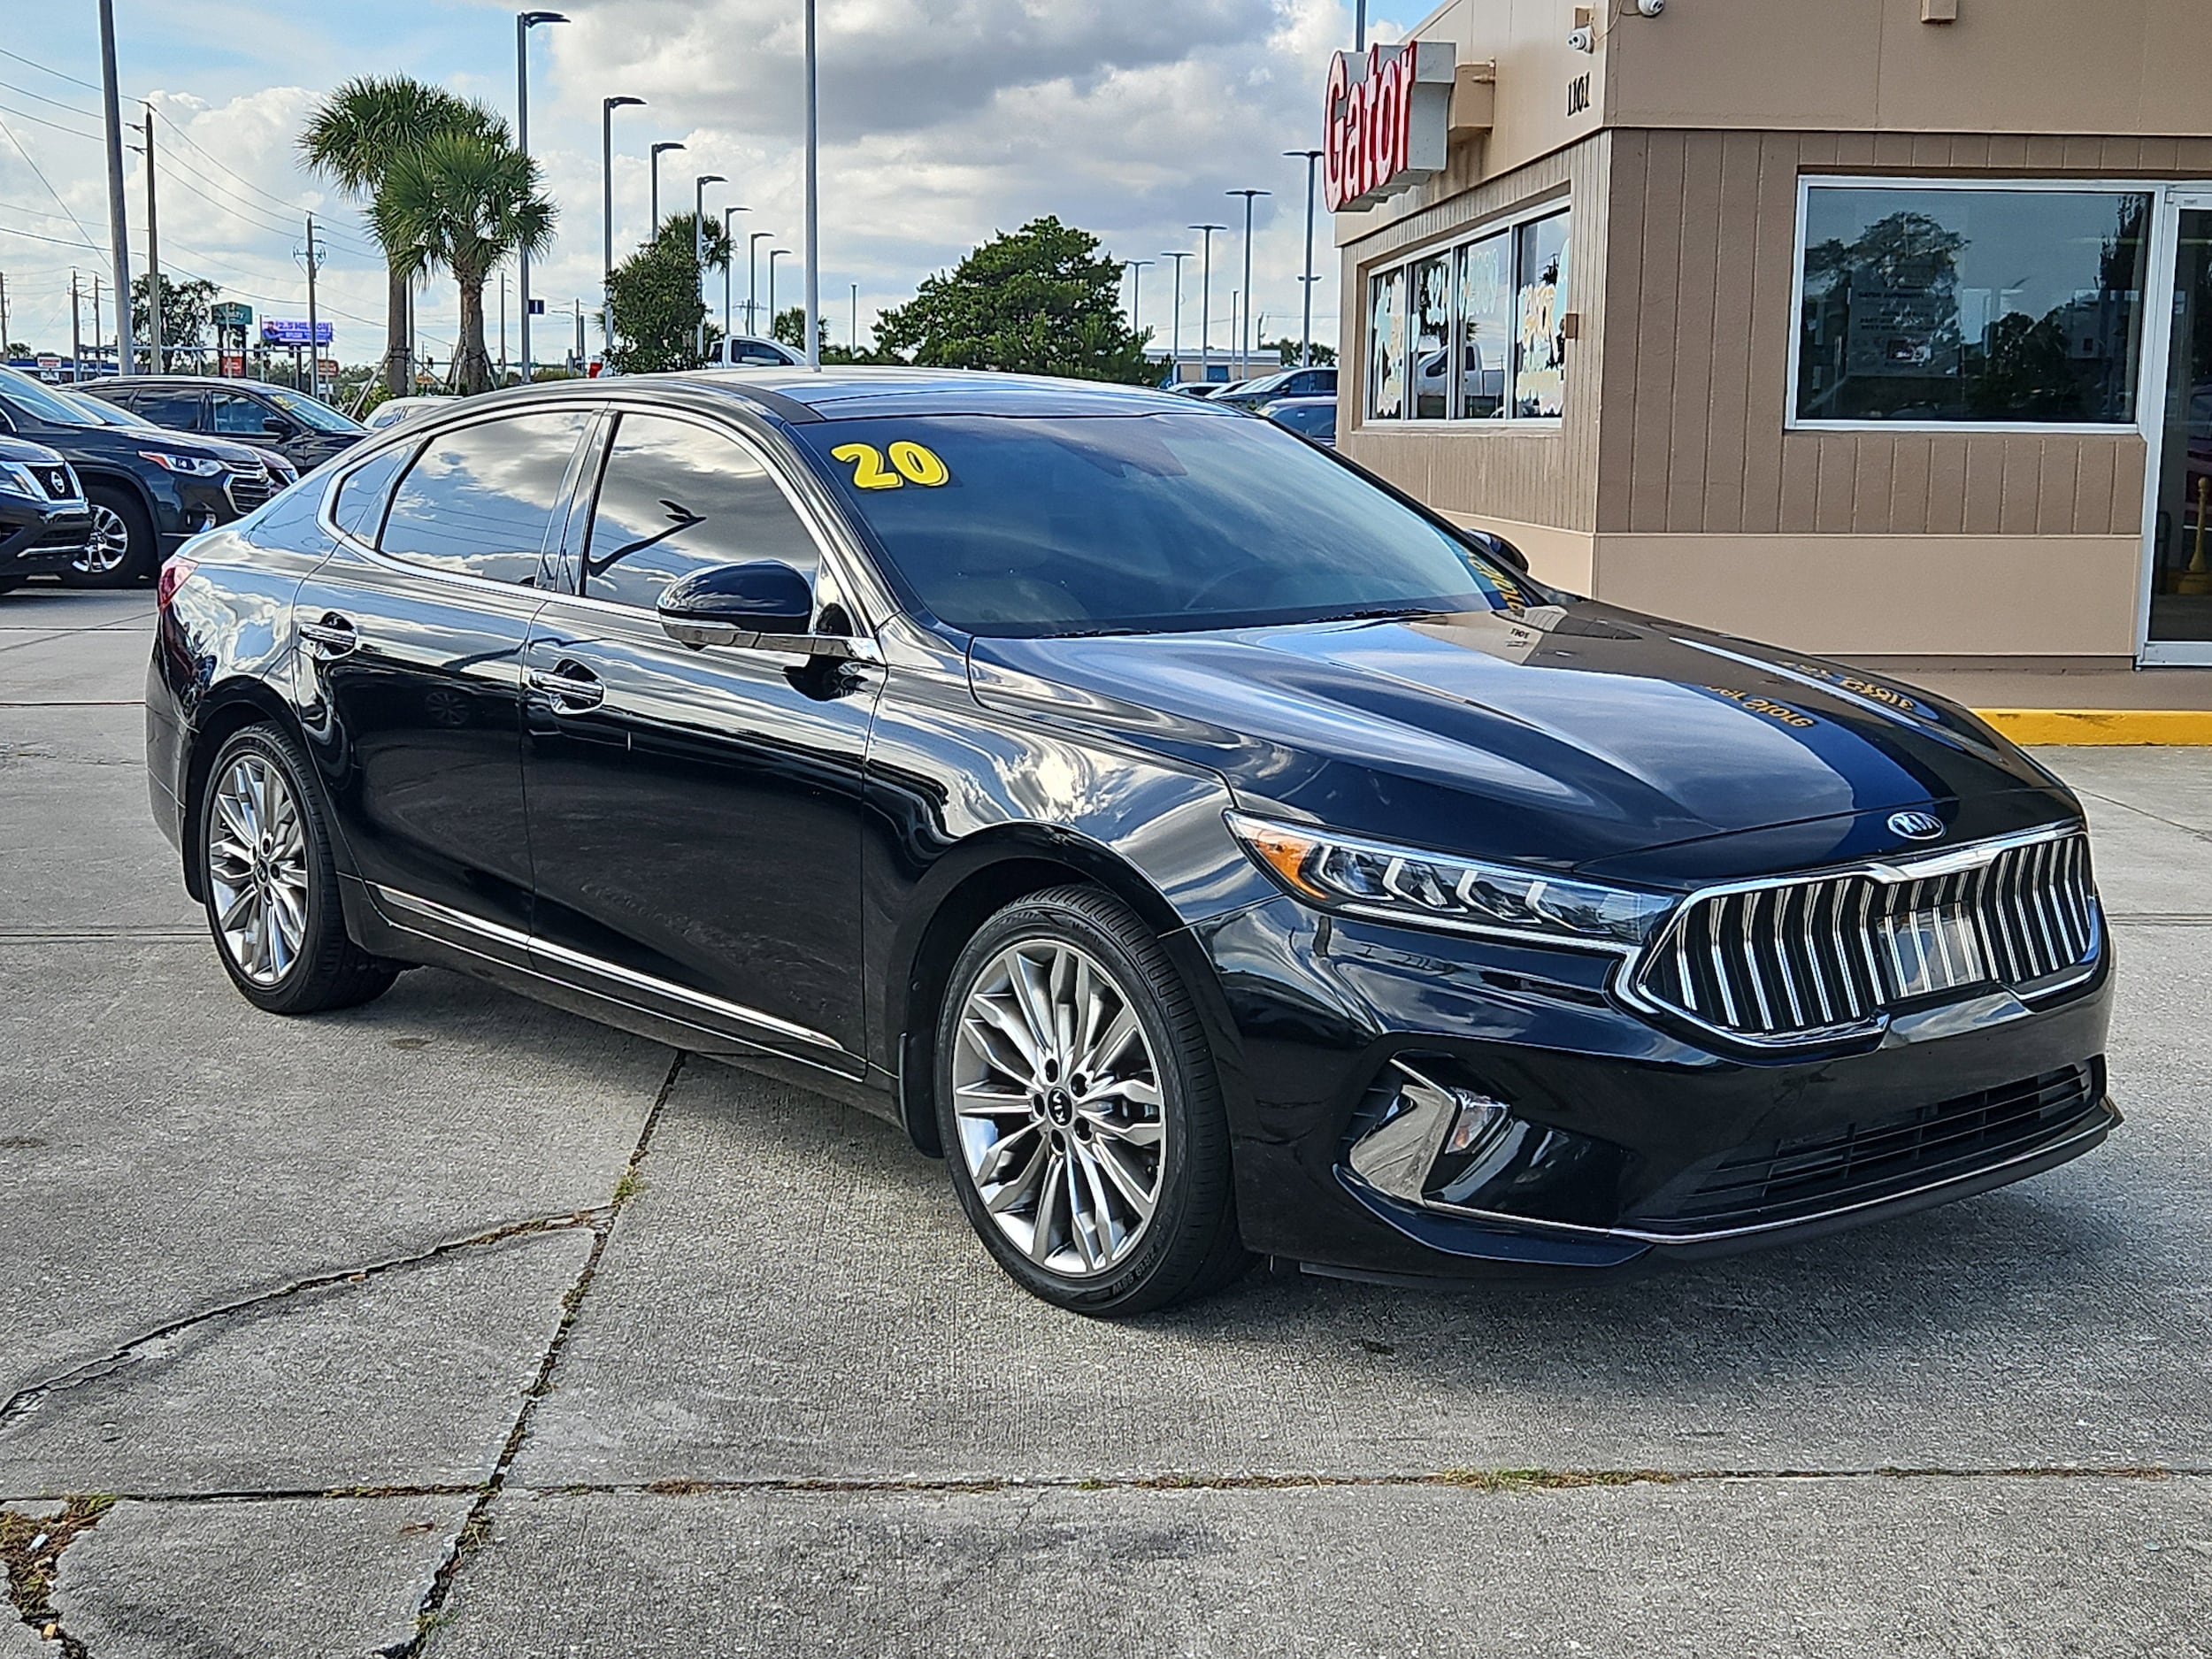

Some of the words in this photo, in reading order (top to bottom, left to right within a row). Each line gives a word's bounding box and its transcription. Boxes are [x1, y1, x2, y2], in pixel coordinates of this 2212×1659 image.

[1567, 71, 1591, 117] 1101
[1324, 40, 1417, 213] Gator
[830, 440, 950, 489] 20
[1892, 812, 1942, 835] KIA
[1052, 1091, 1066, 1123] KIA
